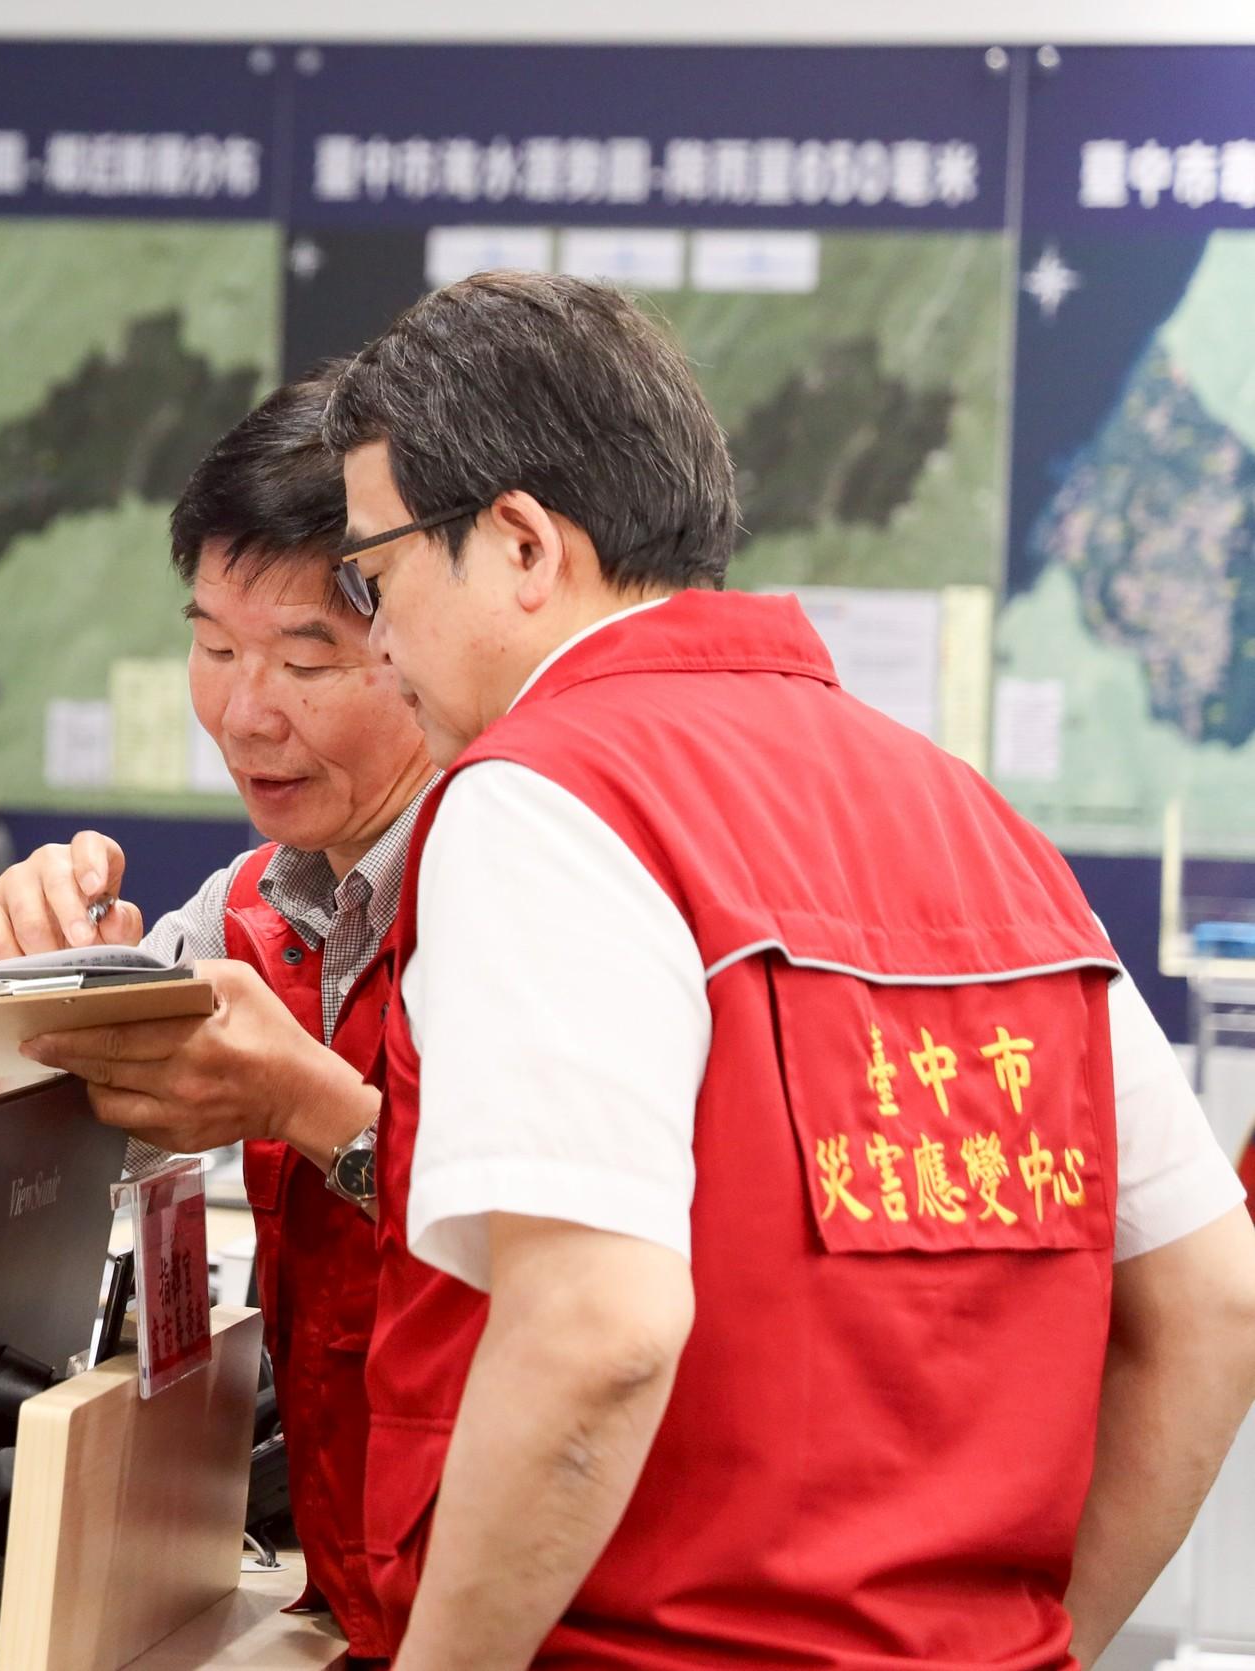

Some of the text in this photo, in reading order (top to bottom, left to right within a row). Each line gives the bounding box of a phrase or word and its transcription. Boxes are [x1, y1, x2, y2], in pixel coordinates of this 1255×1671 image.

[866, 1022, 1035, 1118] 臺中市
[815, 1125, 1088, 1226] 災害應變中心
